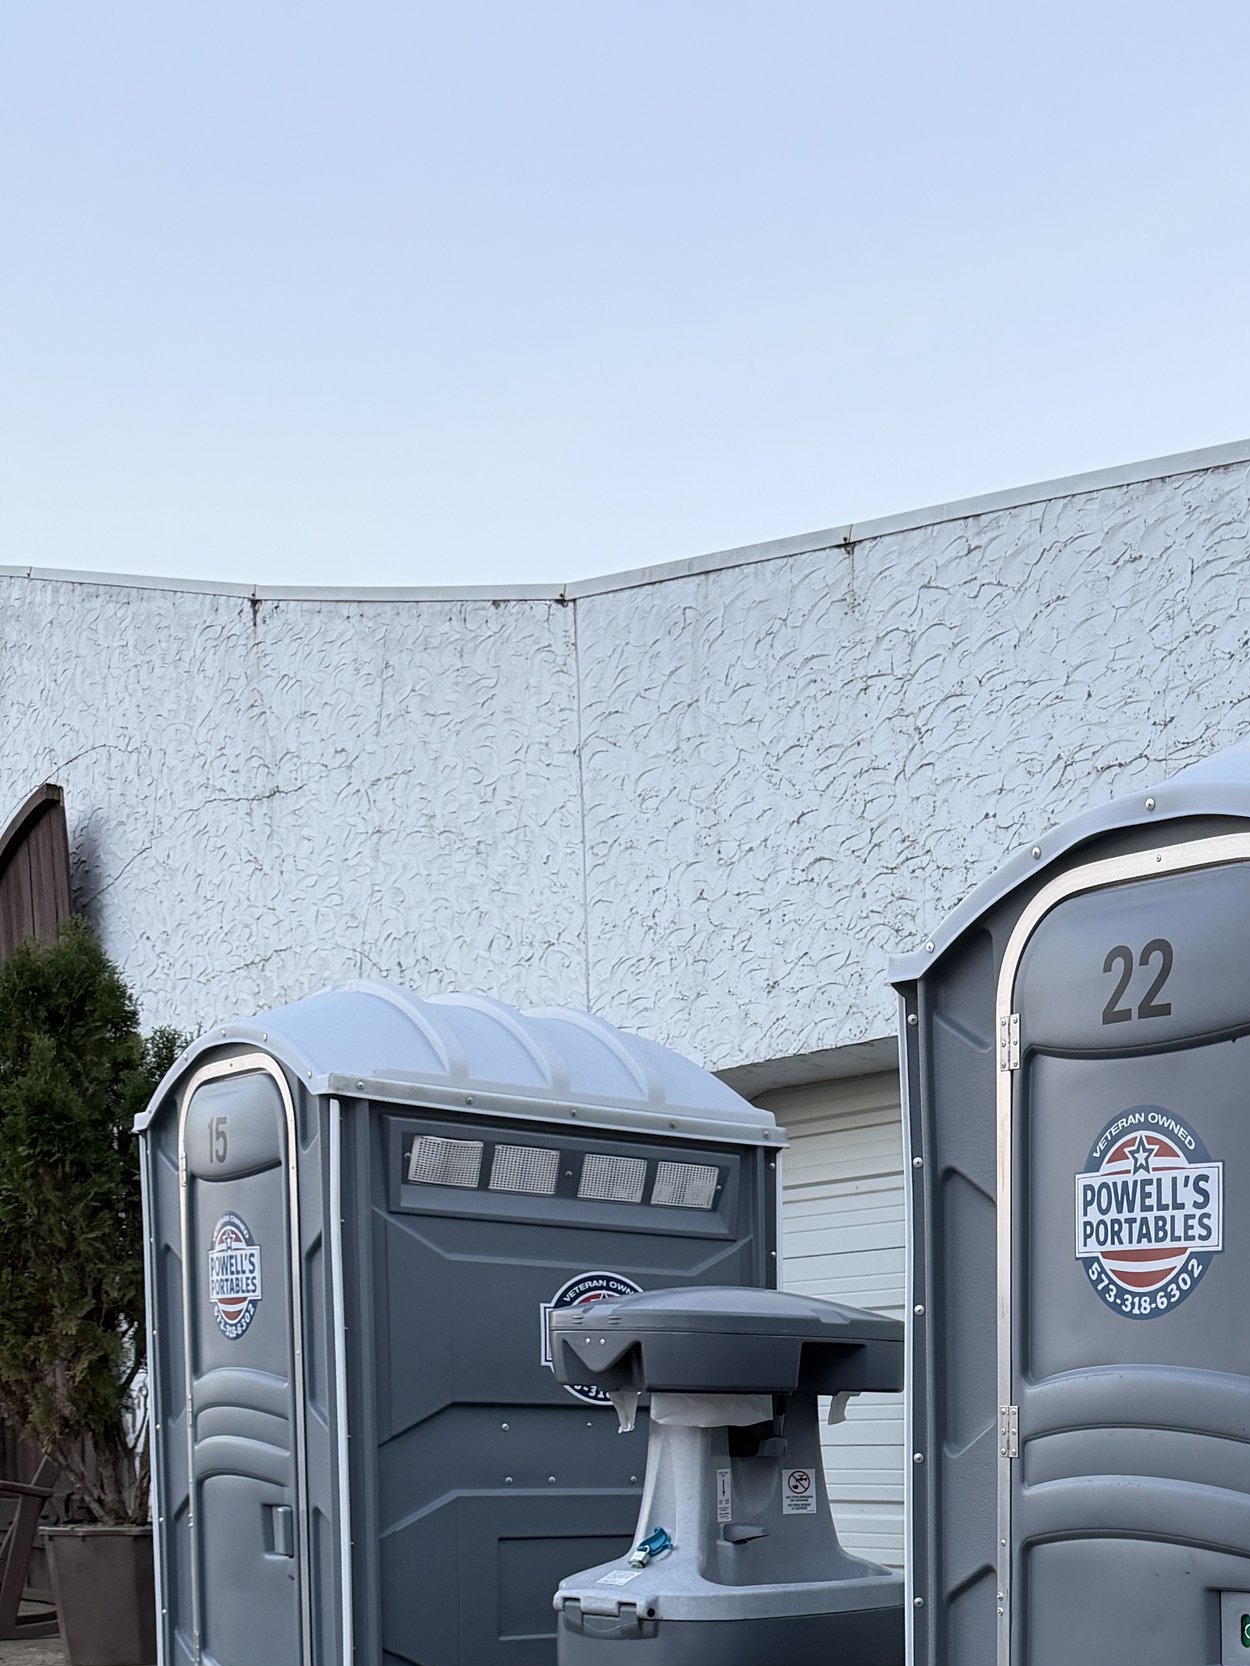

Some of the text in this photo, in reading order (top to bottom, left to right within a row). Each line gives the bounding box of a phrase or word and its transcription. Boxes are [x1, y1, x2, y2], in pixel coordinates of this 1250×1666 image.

[1102, 938, 1174, 1026] 22
[207, 1116, 228, 1164] 15
[1092, 1112, 1196, 1159] VETERAN OWNED
[1082, 1173, 1211, 1218] POWELL'S
[1082, 1212, 1213, 1248] PORTABLES
[210, 1252, 256, 1278] POWELL'S
[210, 1275, 258, 1296] PORTABLES
[1088, 1258, 1203, 1315] 573-318-6302
[562, 1279, 607, 1303] VETERAN
